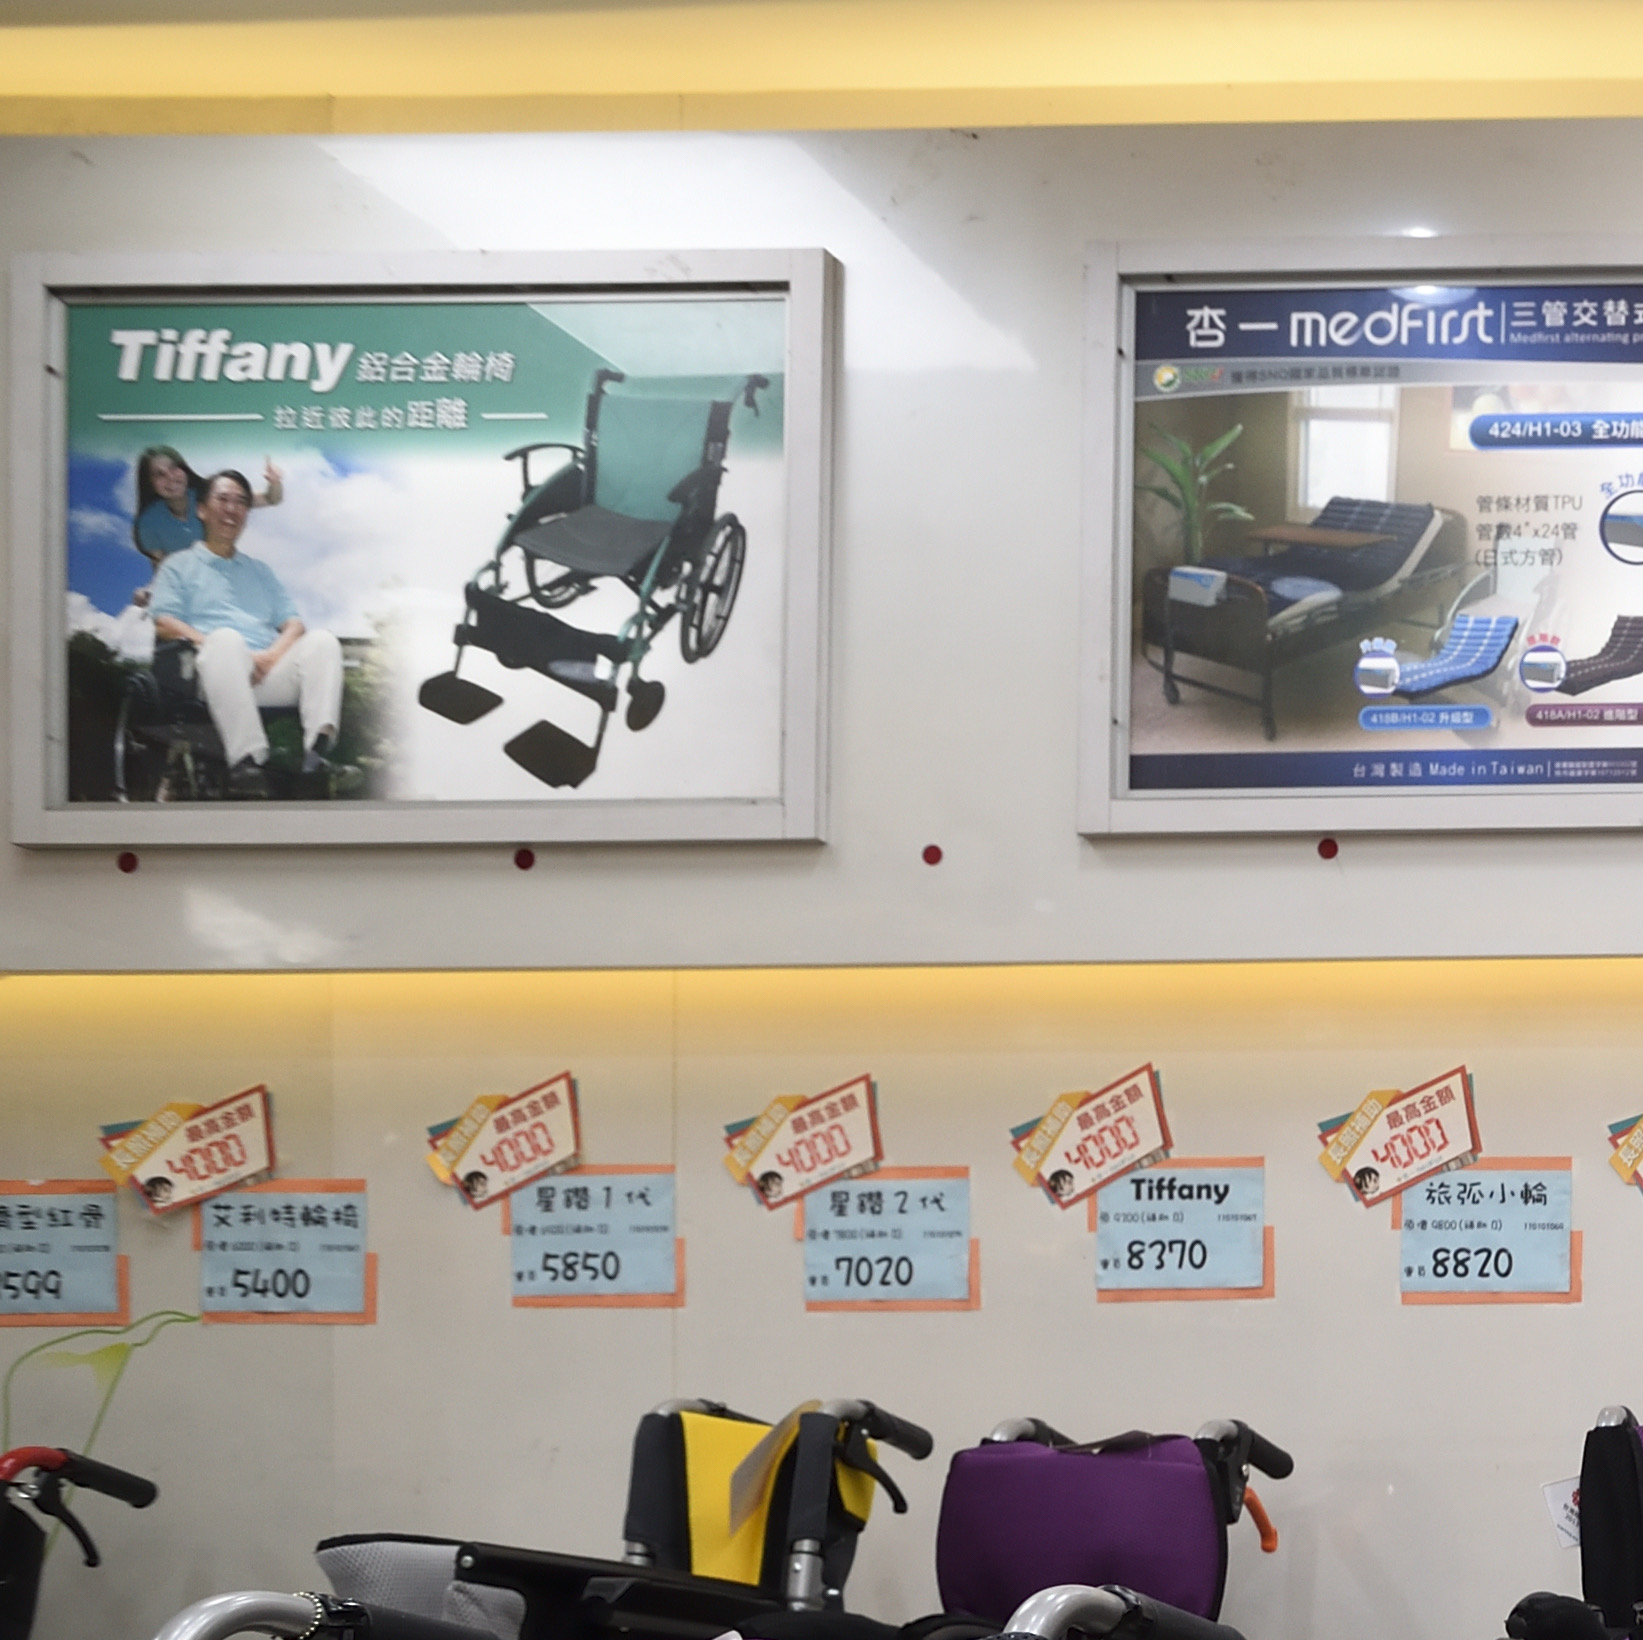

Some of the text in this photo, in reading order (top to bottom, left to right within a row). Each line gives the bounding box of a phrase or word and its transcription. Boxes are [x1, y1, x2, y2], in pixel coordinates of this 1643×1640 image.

[1563, 330, 1630, 345] alternating
[110, 328, 516, 393] Tiffany 鋁合金輪椅
[273, 397, 468, 430] 拉近彼此的距離
[1488, 420, 1582, 438] 424/H1-03
[1353, 762, 1422, 778] 台灣製造
[1429, 762, 1465, 777] Made
[1471, 761, 1486, 776] in
[1491, 761, 1544, 775] Taiwan
[776, 1124, 851, 1173] 4000
[1064, 1116, 1140, 1170] 4000
[1372, 1117, 1449, 1169] 4000
[1131, 1177, 1230, 1204] Tiffany
[542, 1251, 620, 1281] 5850
[1127, 1239, 1207, 1270] 8370
[1432, 1248, 1512, 1278] 8820
[231, 1268, 311, 1299] 5400
[835, 1256, 913, 1286] 7020
